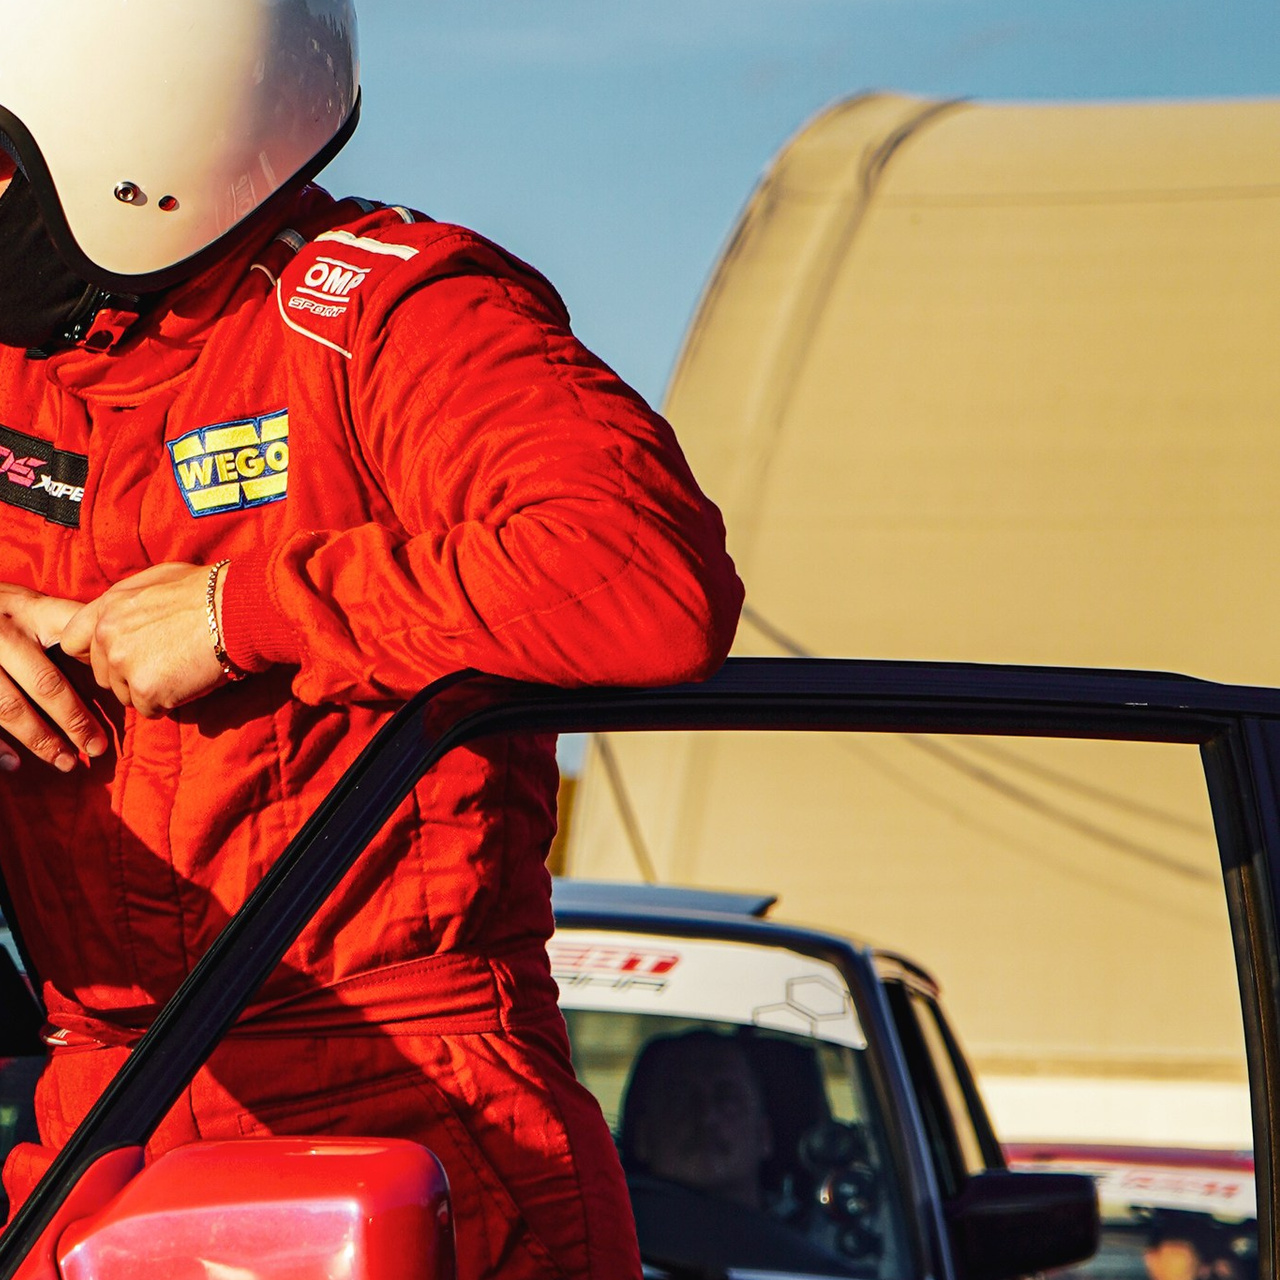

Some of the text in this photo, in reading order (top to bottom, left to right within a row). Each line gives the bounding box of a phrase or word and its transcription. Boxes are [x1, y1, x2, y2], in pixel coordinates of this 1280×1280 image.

[304, 263, 366, 295] OMP
[288, 296, 347, 318] SPORT
[177, 441, 289, 490] WEGO
